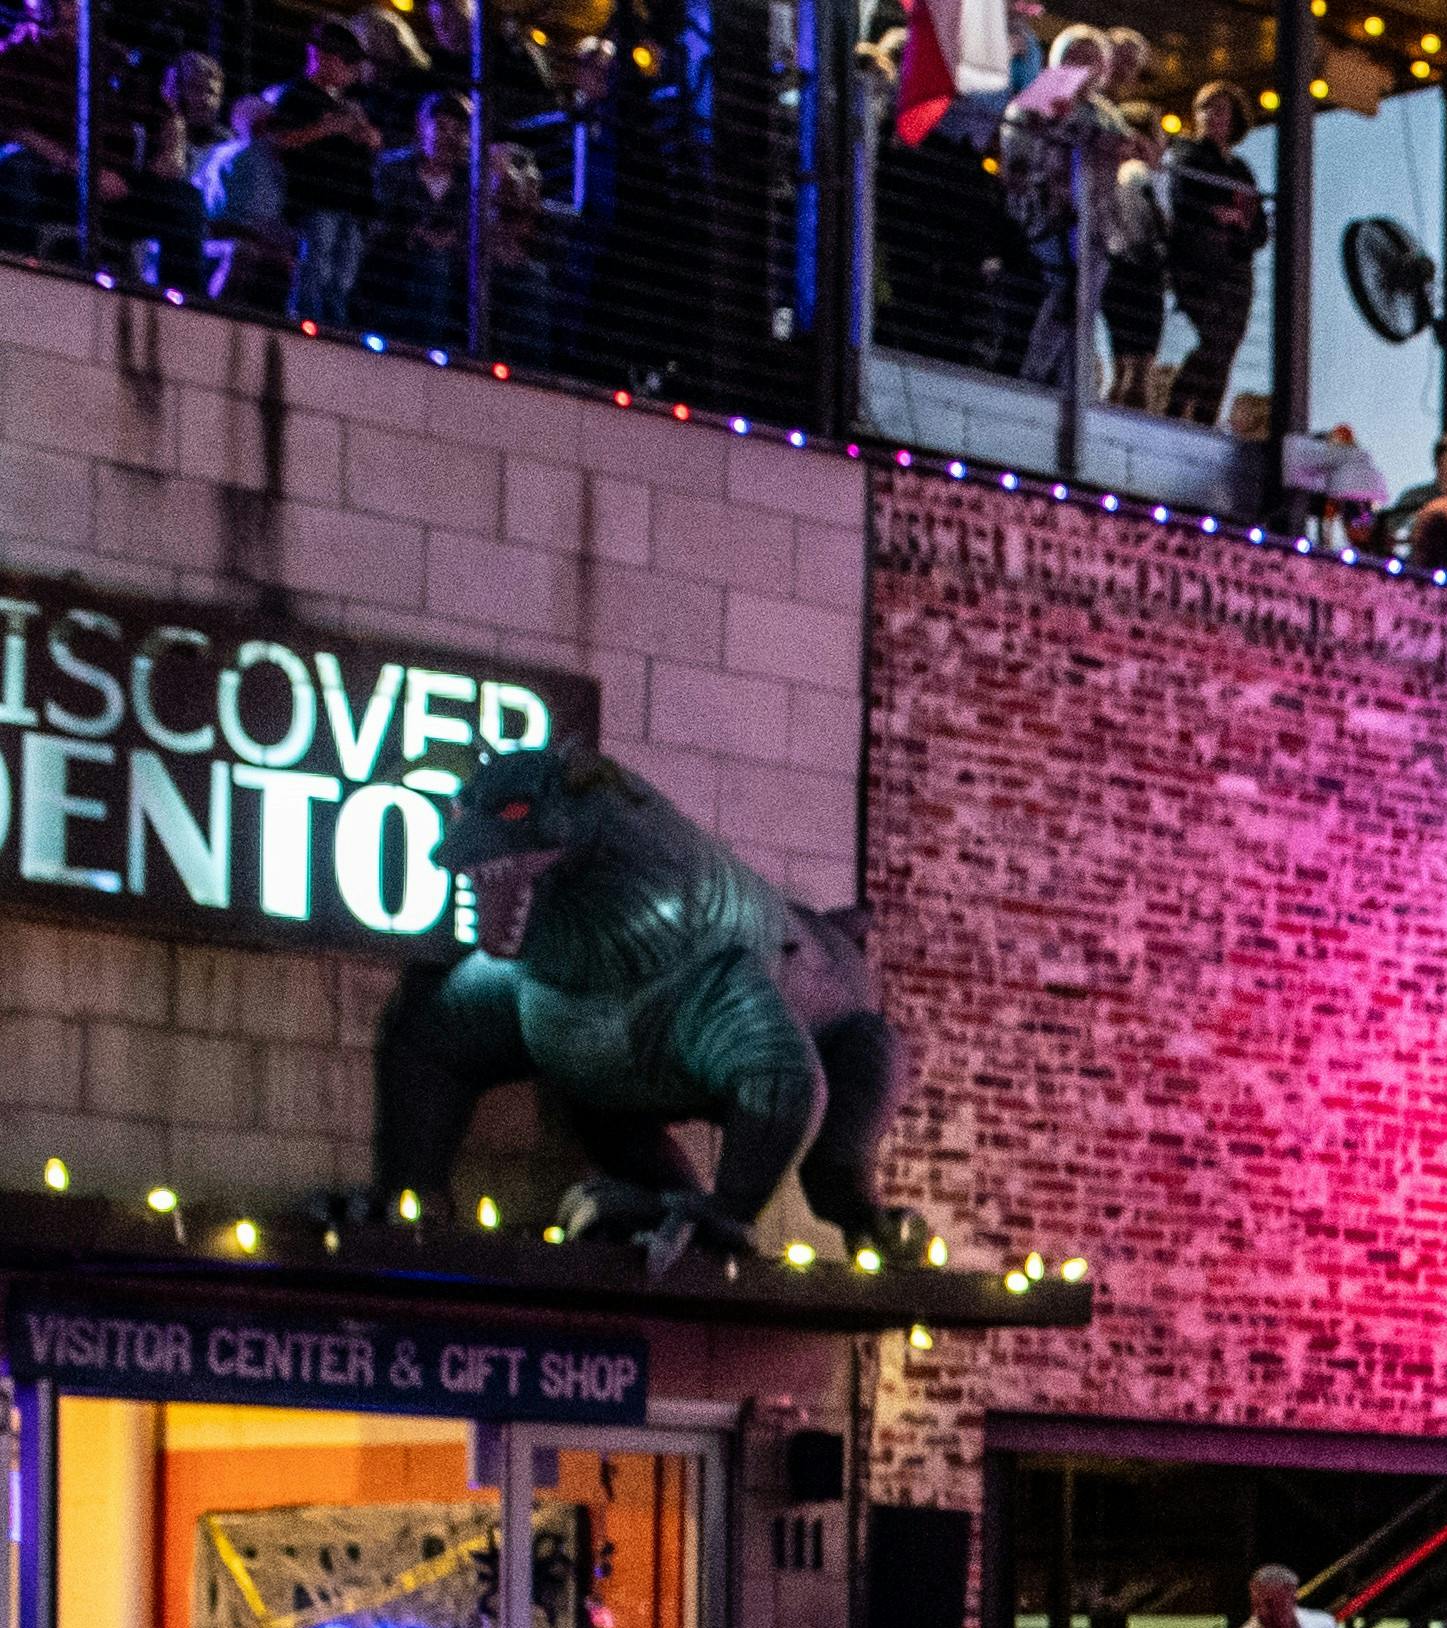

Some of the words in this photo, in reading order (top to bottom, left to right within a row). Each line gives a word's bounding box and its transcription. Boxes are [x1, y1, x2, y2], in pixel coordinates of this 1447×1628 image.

[0, 600, 549, 797] ISCOVER
[0, 730, 478, 945] ENTO
[25, 1313, 192, 1376] VISITOR
[207, 1327, 374, 1387] CENTER
[391, 1340, 422, 1390] &
[440, 1344, 527, 1397] GIFT
[539, 1351, 640, 1402] SHOP
